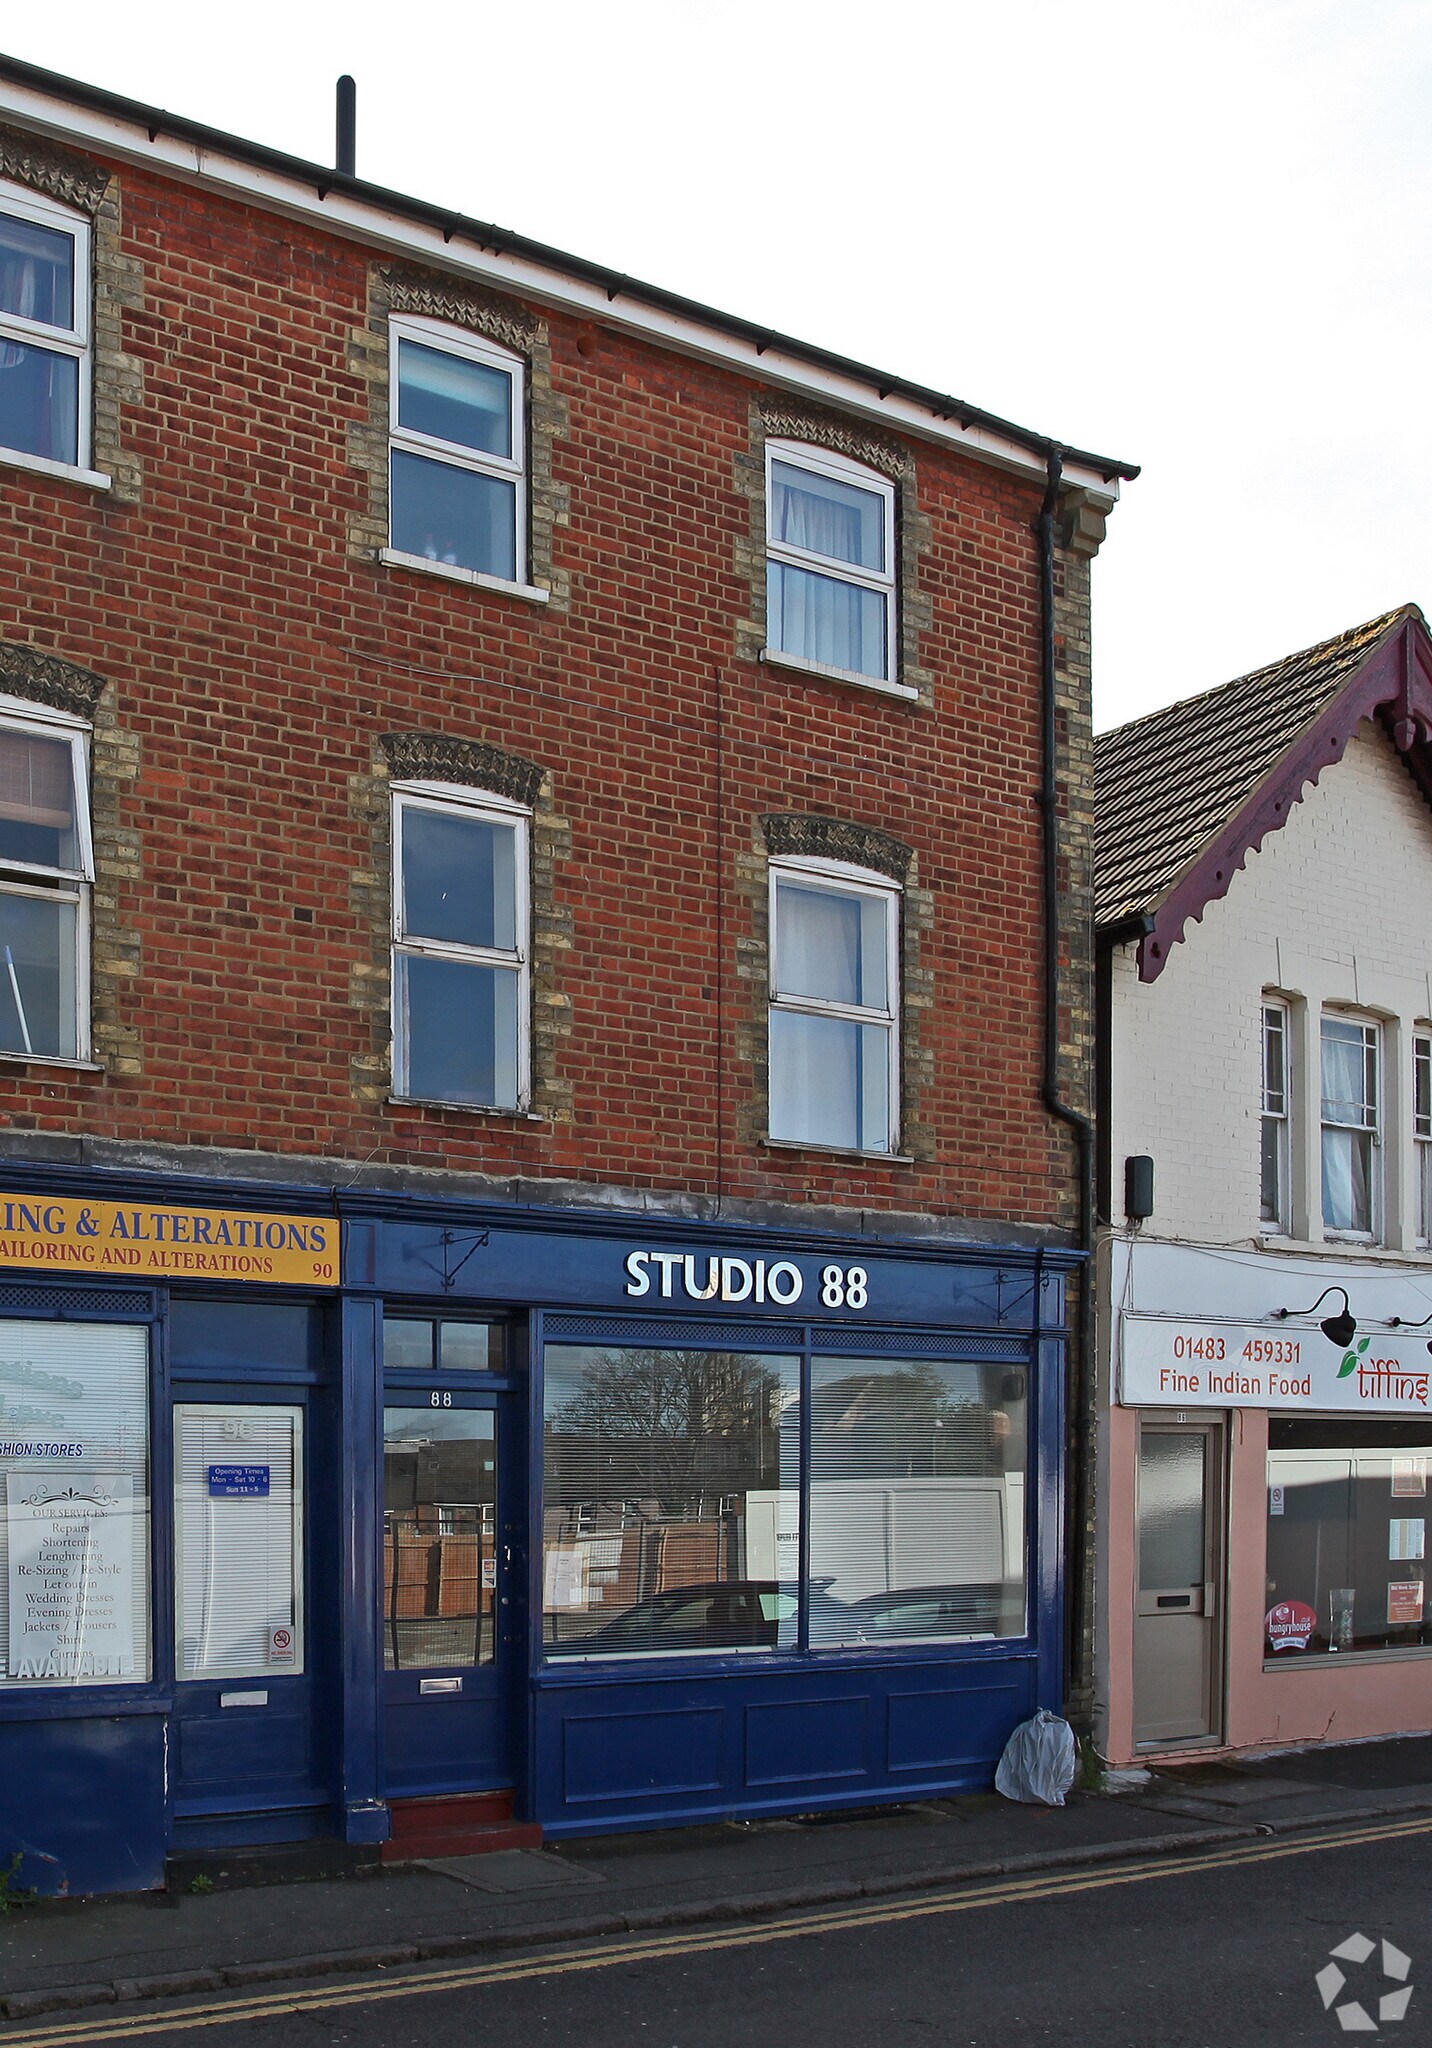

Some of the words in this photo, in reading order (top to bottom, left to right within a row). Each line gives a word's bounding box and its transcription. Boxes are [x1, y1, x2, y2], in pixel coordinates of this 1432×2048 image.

[0, 1203, 66, 1235] ING
[76, 1208, 100, 1237] &
[109, 1211, 327, 1252] ALTERATIONS
[100, 1247, 142, 1265] AND
[148, 1249, 273, 1274] ALTERATIONS
[312, 1262, 333, 1279] 90
[626, 1250, 803, 1306] STUDIO
[821, 1265, 868, 1310] 88
[1173, 1335, 1226, 1361] 01483
[1242, 1340, 1301, 1364] 459331
[1160, 1369, 1199, 1393] Fine
[1208, 1371, 1261, 1395] Indian
[1269, 1374, 1311, 1396] Food
[431, 1391, 452, 1408] 88
[36, 1443, 83, 1457] STORES
[214, 1467, 243, 1476] Opening
[245, 1467, 264, 1475] Times
[33, 1508, 56, 1518] OUR
[59, 1508, 108, 1518] SERVICES:
[52, 1523, 90, 1536] Repairs
[42, 1536, 99, 1549] Shortening
[38, 1551, 103, 1564] Lenghtening
[17, 1565, 69, 1578] Re-Sizing
[81, 1564, 121, 1577] Re-Style
[44, 1579, 62, 1589] Let
[25, 1593, 72, 1606] Wedding
[76, 1592, 115, 1602] Dresses
[27, 1606, 71, 1619] Evening
[75, 1606, 113, 1616] Dresses
[23, 1621, 60, 1635] Jackets
[57, 1634, 87, 1645] Shirts
[17, 1655, 134, 1679] AVAILABLE
